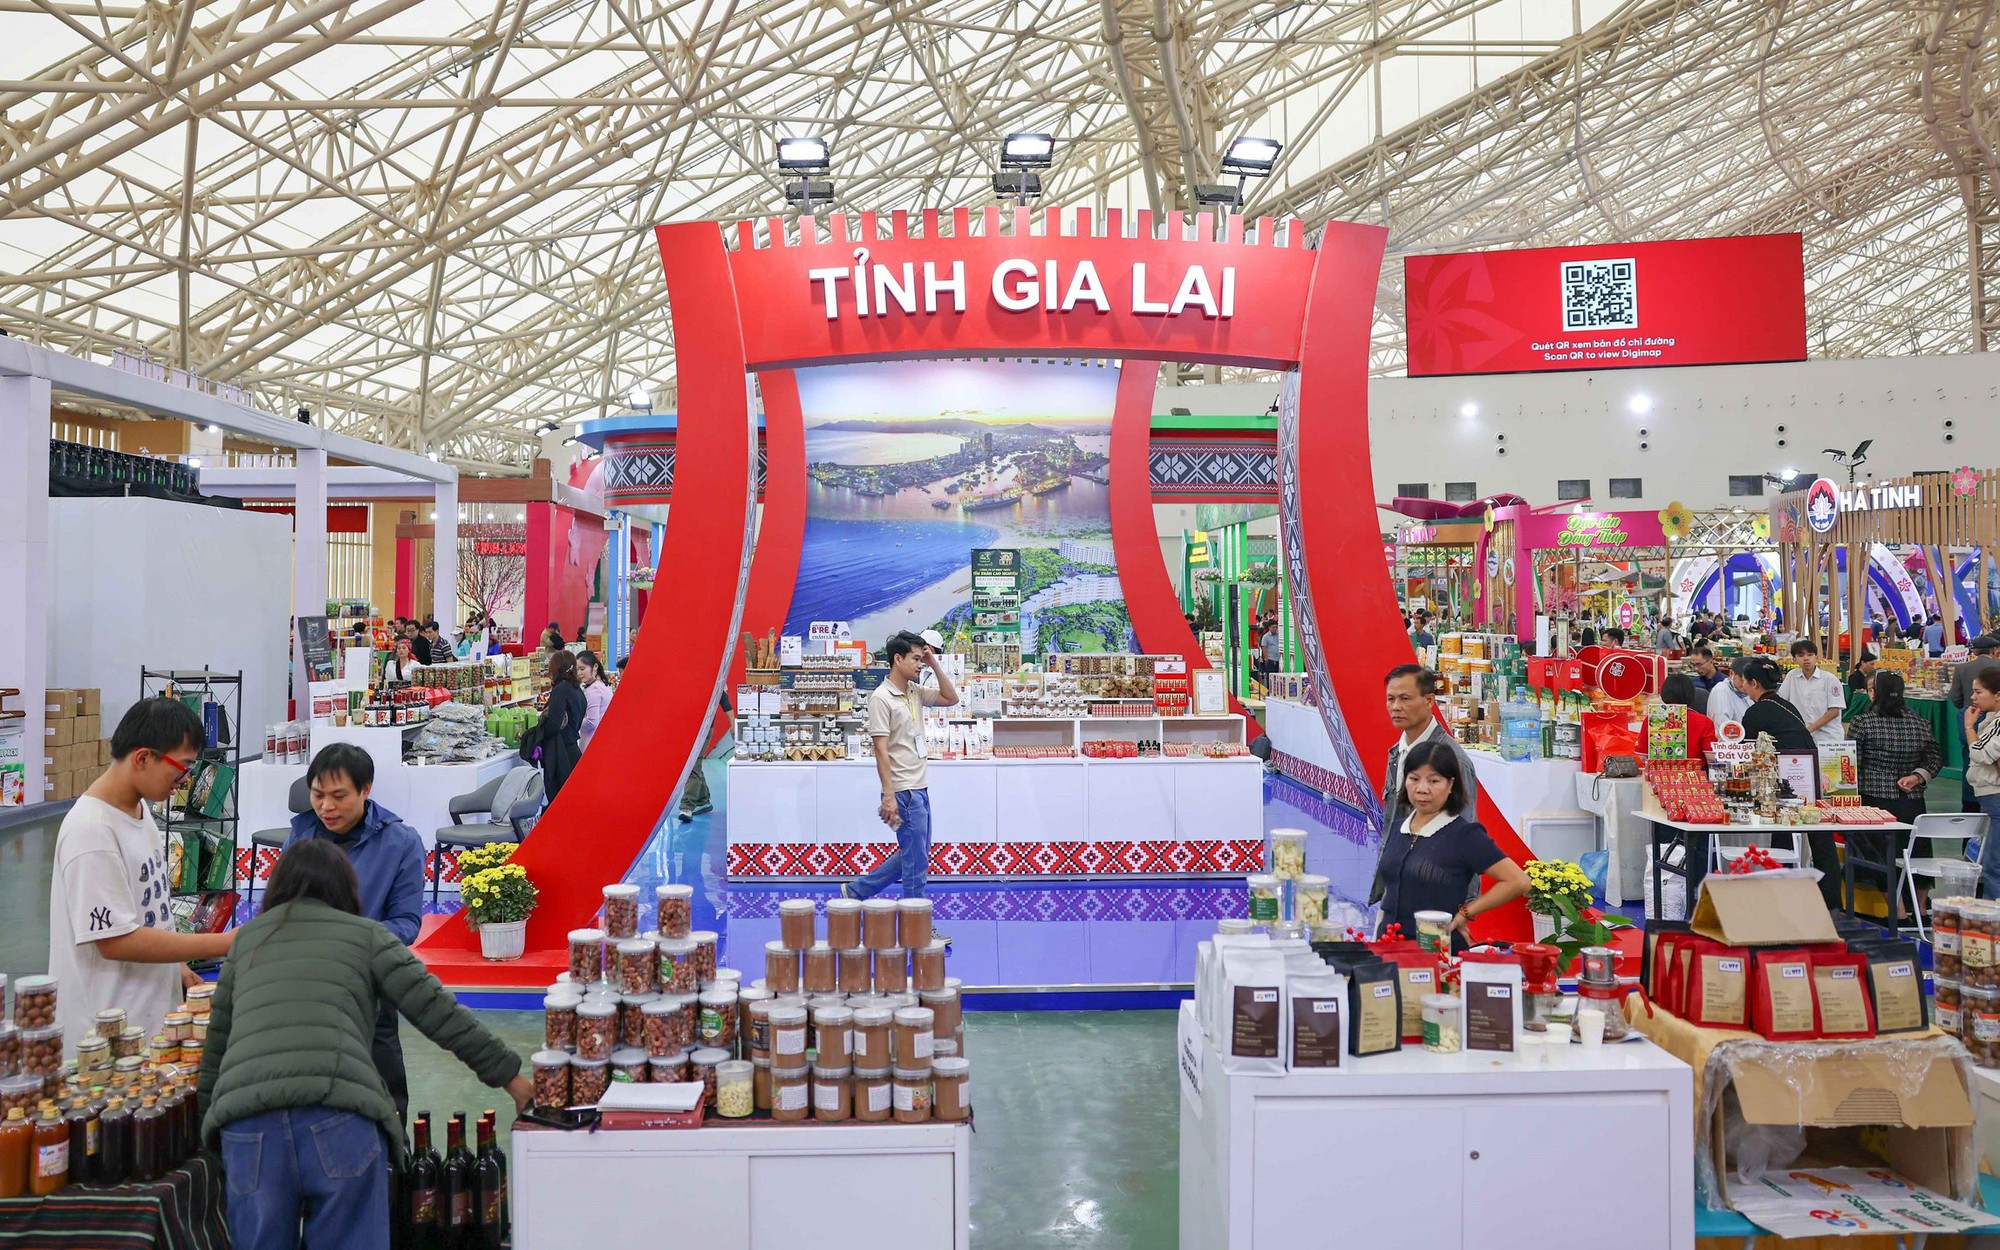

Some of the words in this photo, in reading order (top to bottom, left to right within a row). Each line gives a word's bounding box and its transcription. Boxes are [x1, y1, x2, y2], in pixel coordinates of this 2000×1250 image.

[808, 247, 966, 319] TỈNH
[991, 259, 1110, 312] GIA
[1132, 262, 1236, 319] LAI
[1532, 342, 1554, 350] Quét
[1622, 349, 1662, 358] Digimap
[1595, 529, 1628, 546] Tháp
